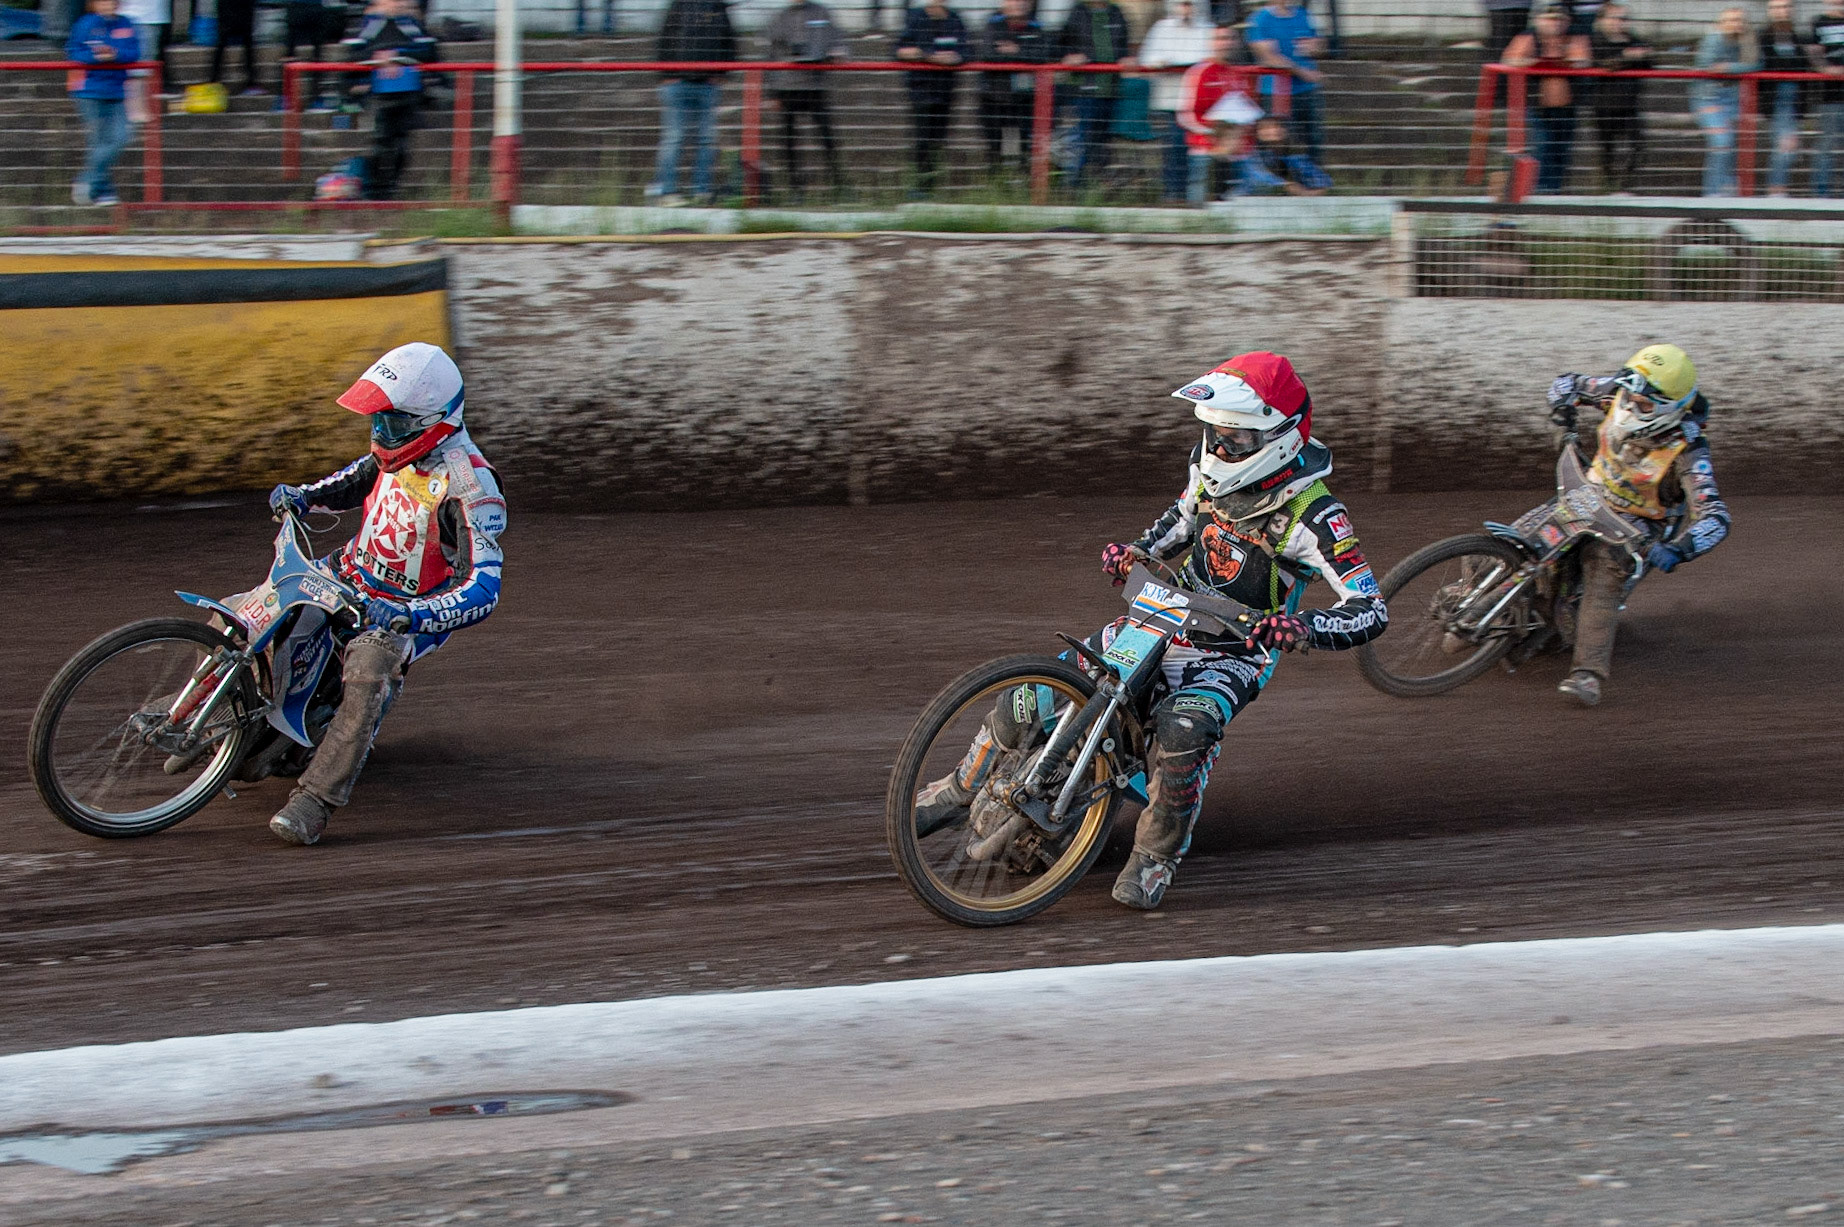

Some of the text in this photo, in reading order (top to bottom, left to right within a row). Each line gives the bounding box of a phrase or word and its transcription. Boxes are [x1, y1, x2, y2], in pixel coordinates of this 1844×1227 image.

[1270, 512, 1290, 535] 3
[356, 547, 419, 591] POTTERS
[300, 579, 323, 598] CYCLES
[1141, 583, 1168, 602] KJM
[411, 586, 468, 615] Spot
[439, 607, 462, 622] On
[1107, 650, 1125, 662] ROCK
